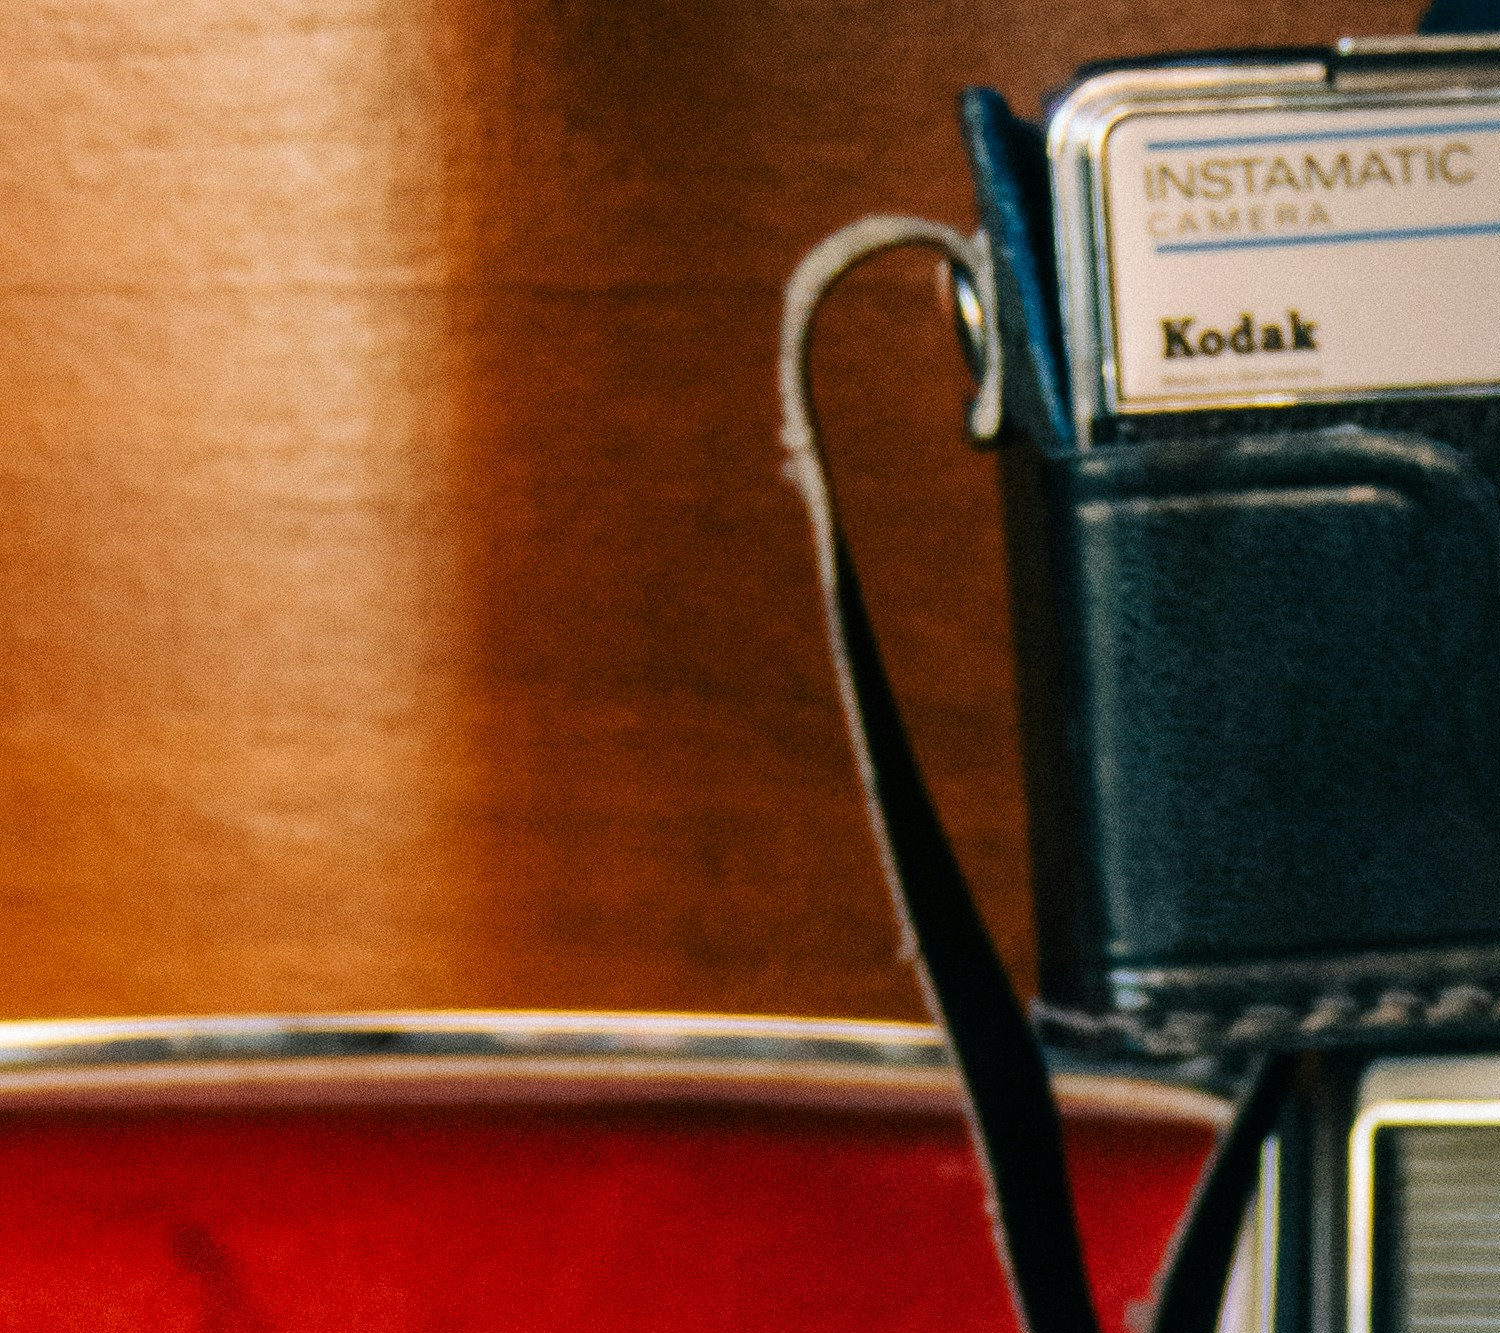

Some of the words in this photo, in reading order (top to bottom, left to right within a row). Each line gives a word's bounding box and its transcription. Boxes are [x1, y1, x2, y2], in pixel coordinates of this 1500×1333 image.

[1143, 142, 1476, 202] INSTAMATIC
[1146, 200, 1334, 240] CAMERA
[1160, 308, 1319, 360] Kodak
